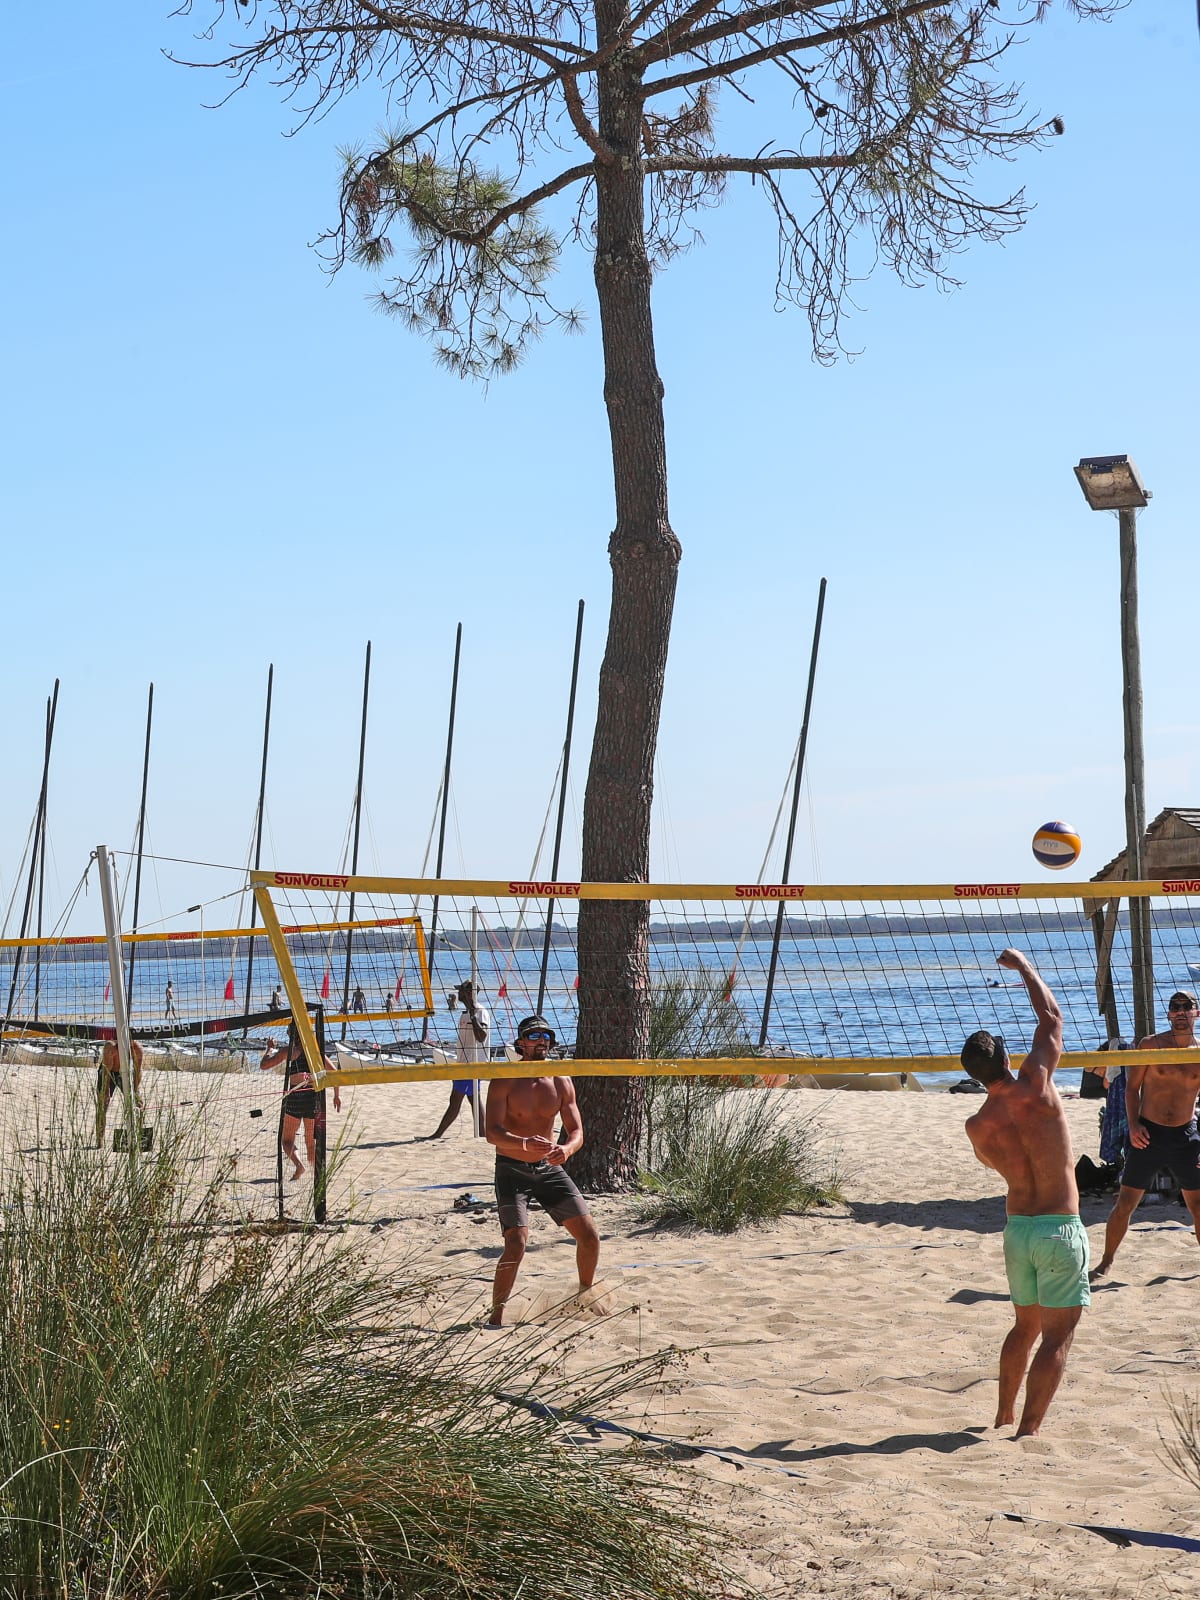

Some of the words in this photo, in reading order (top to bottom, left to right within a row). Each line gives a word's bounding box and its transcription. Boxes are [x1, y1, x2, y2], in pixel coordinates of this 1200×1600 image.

[274, 872, 349, 888] SUNVOLLEY
[509, 881, 581, 895] SUNVOLLEY
[735, 885, 805, 898] SUNVOLLEY
[954, 884, 1021, 897] SUNVOLLEY
